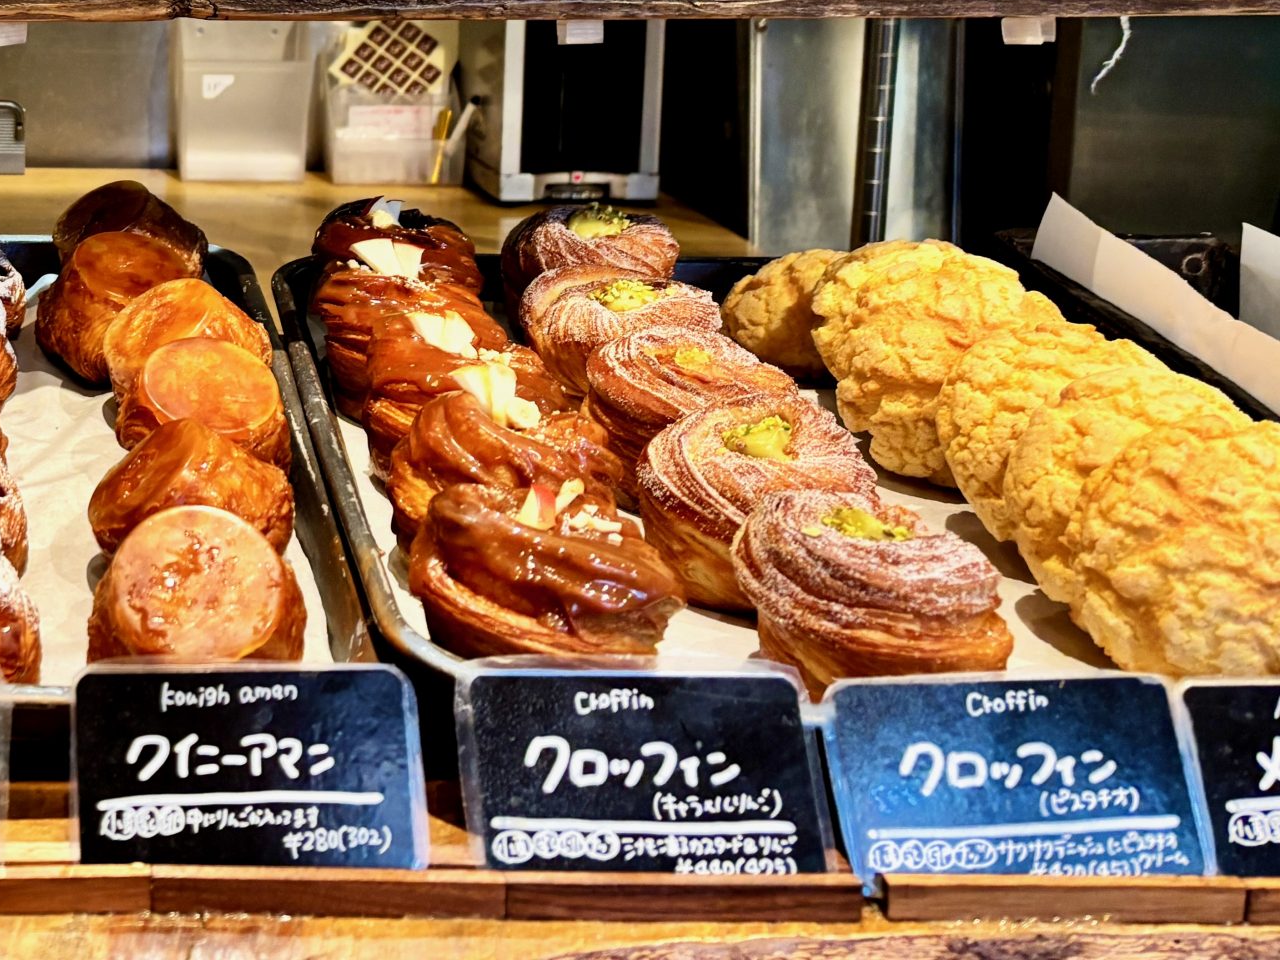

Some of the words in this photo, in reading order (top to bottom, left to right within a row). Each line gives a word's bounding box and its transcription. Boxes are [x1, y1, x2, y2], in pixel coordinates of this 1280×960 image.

[238, 683, 299, 708] aman
[125, 731, 336, 782] クイニーアマン
[523, 734, 742, 795] クロッフィン
[898, 740, 1118, 797] クロッフィン
[282, 825, 393, 860] ¥280(302)
